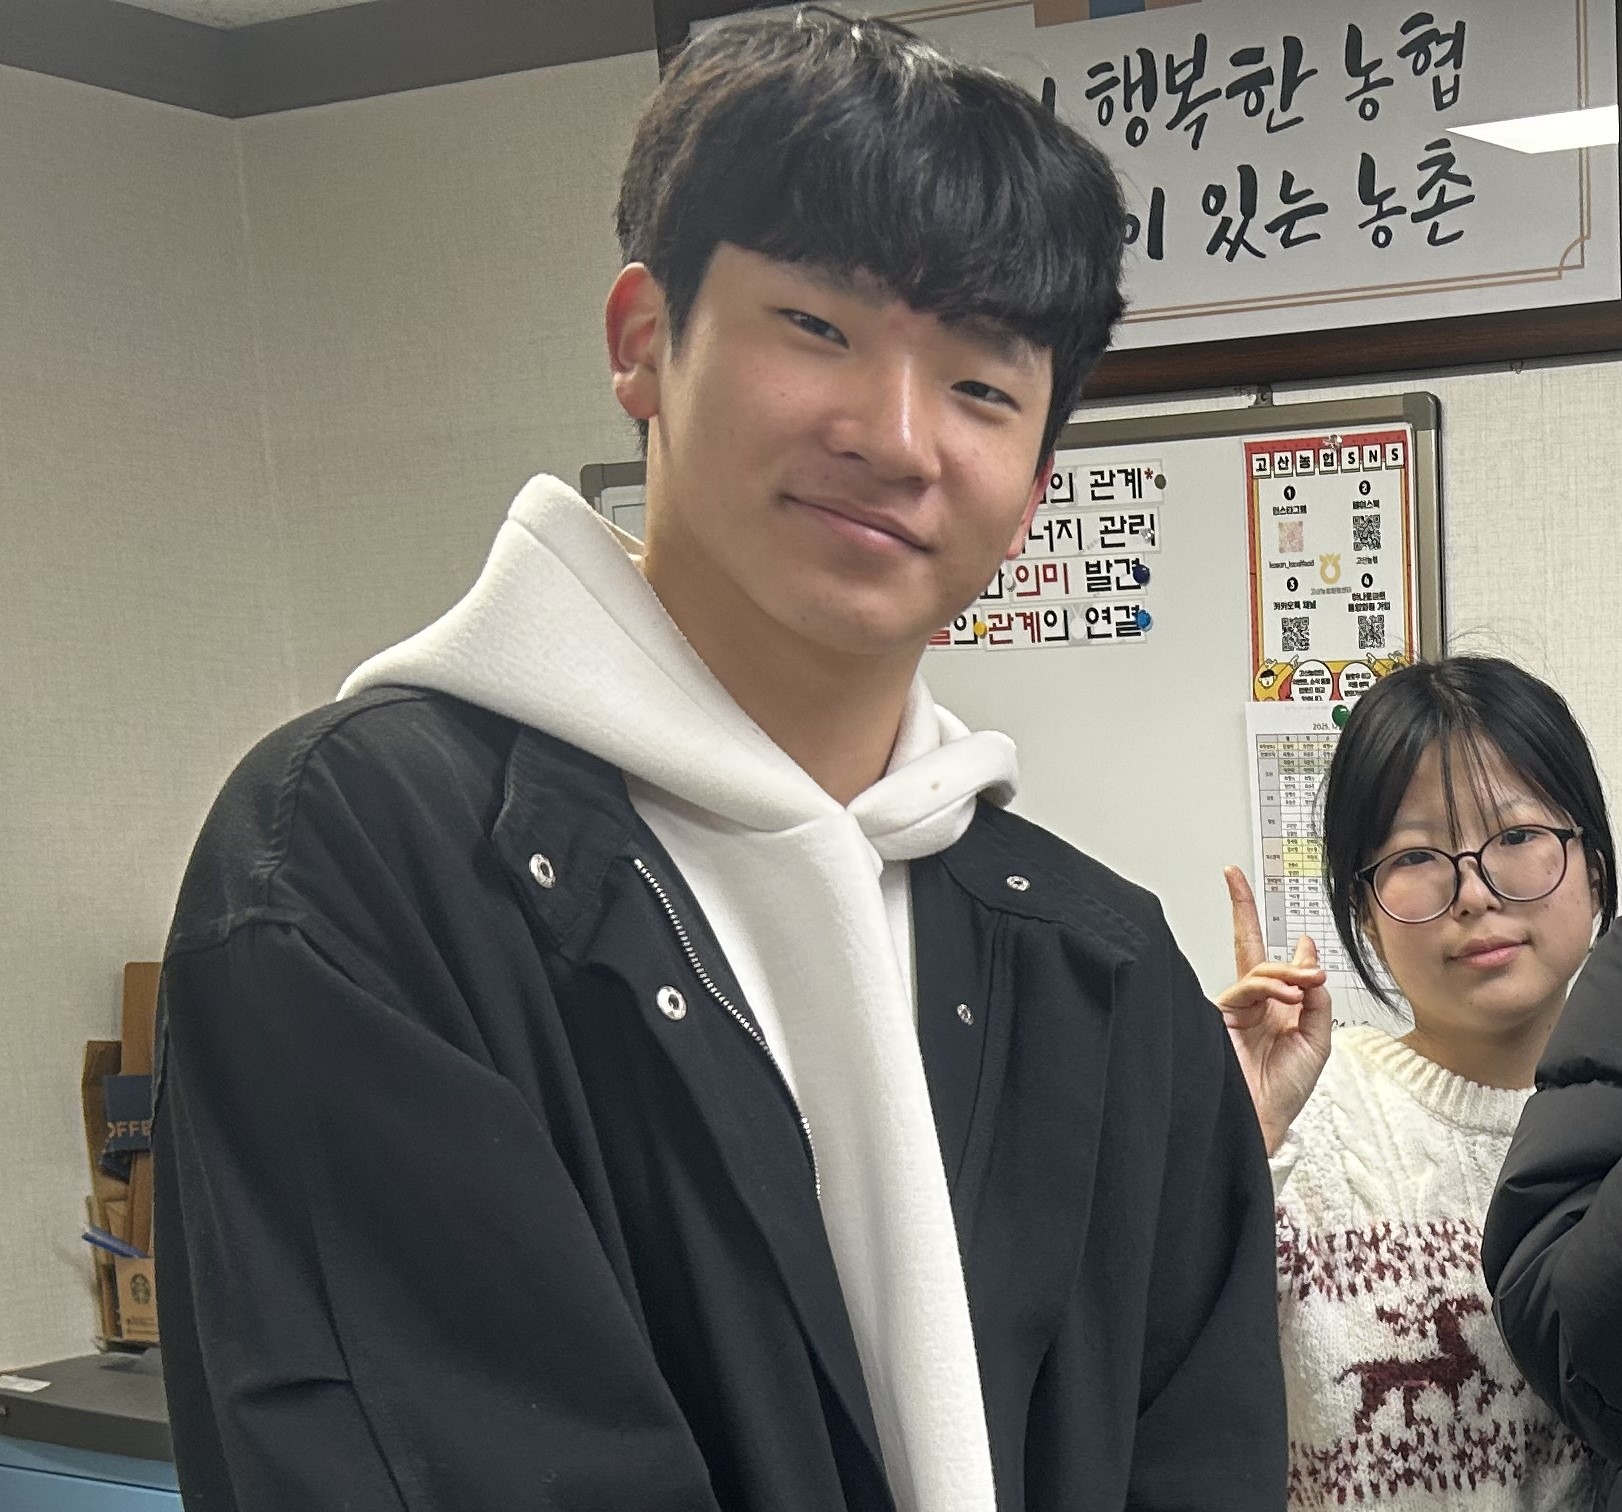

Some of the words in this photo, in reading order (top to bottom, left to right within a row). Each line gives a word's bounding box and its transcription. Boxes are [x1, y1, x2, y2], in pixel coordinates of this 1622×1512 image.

[1085, 34, 1317, 150] 행복한
[1345, 11, 1467, 122] 농협
[1124, 185, 1164, 260] 이
[1201, 164, 1328, 263] 있는
[1357, 137, 1476, 249] 농촌
[1348, 448, 1399, 465] SNS
[1039, 472, 1074, 504] 의
[1090, 468, 1143, 501] 관계
[1022, 518, 1083, 554] 너지
[1099, 513, 1156, 549] 관리
[1015, 562, 1070, 597] 의미
[1085, 558, 1142, 593] 발견
[988, 610, 1070, 645] 관계의
[1085, 605, 1142, 640] 연결
